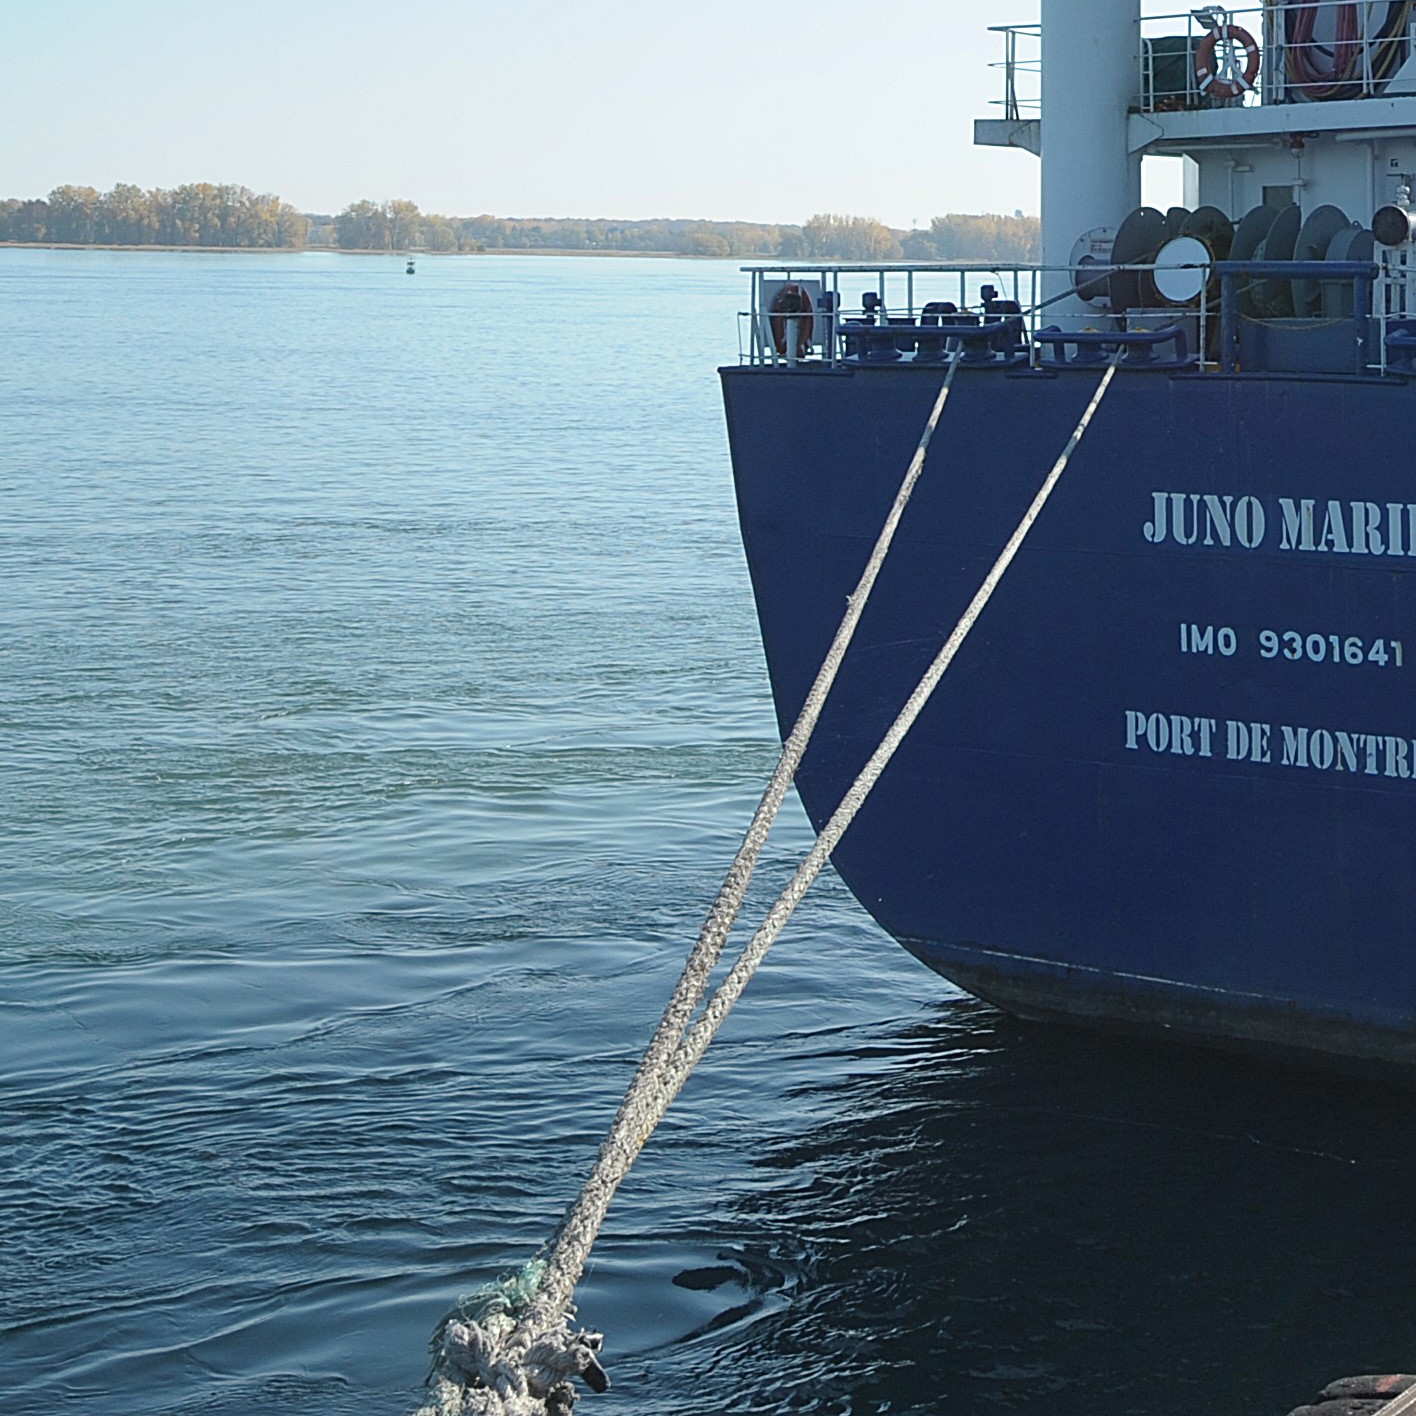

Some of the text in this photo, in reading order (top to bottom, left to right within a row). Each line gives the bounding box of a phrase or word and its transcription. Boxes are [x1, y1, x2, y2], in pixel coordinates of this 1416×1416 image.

[1143, 492, 1266, 549] JUNO
[1180, 623, 1403, 667] IMO 9301641
[1125, 710, 1216, 757] PORT
[1226, 720, 1271, 763] DE
